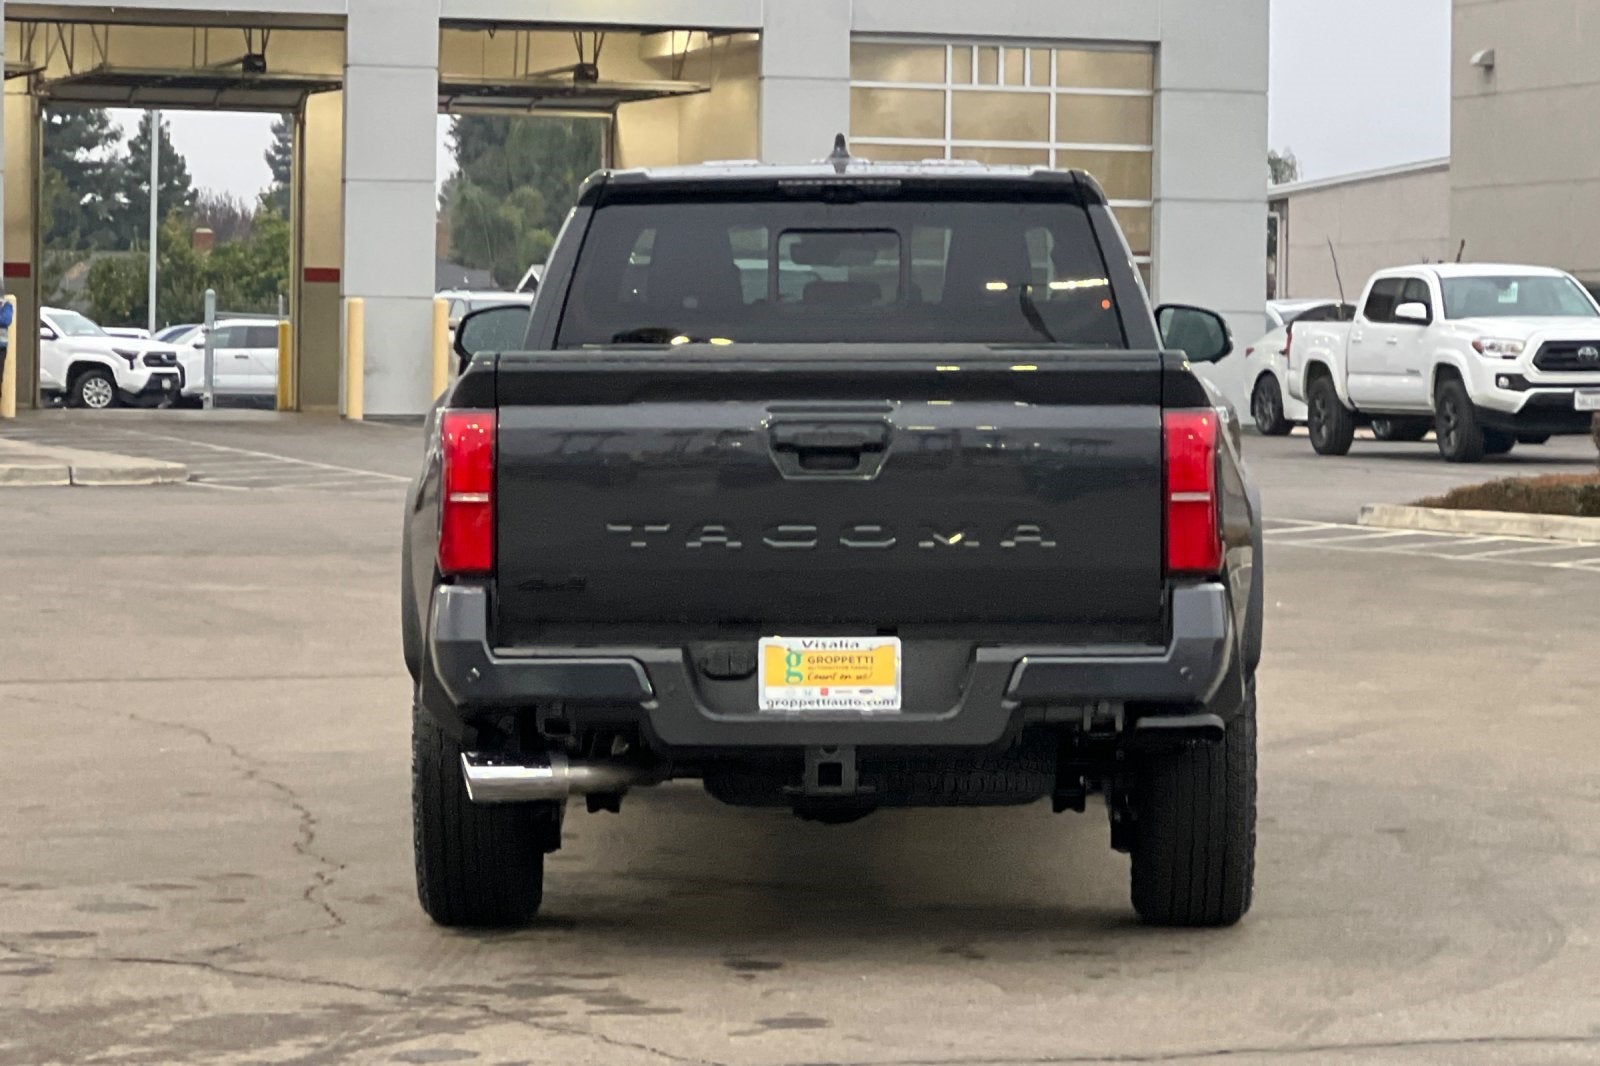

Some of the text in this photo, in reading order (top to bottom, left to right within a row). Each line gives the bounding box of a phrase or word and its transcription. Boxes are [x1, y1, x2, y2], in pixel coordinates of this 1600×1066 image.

[605, 523, 1057, 548] TACOMA
[802, 639, 860, 649] Visalia
[807, 655, 874, 664] GROPPETTI
[766, 698, 896, 709] groppettiauto.com
